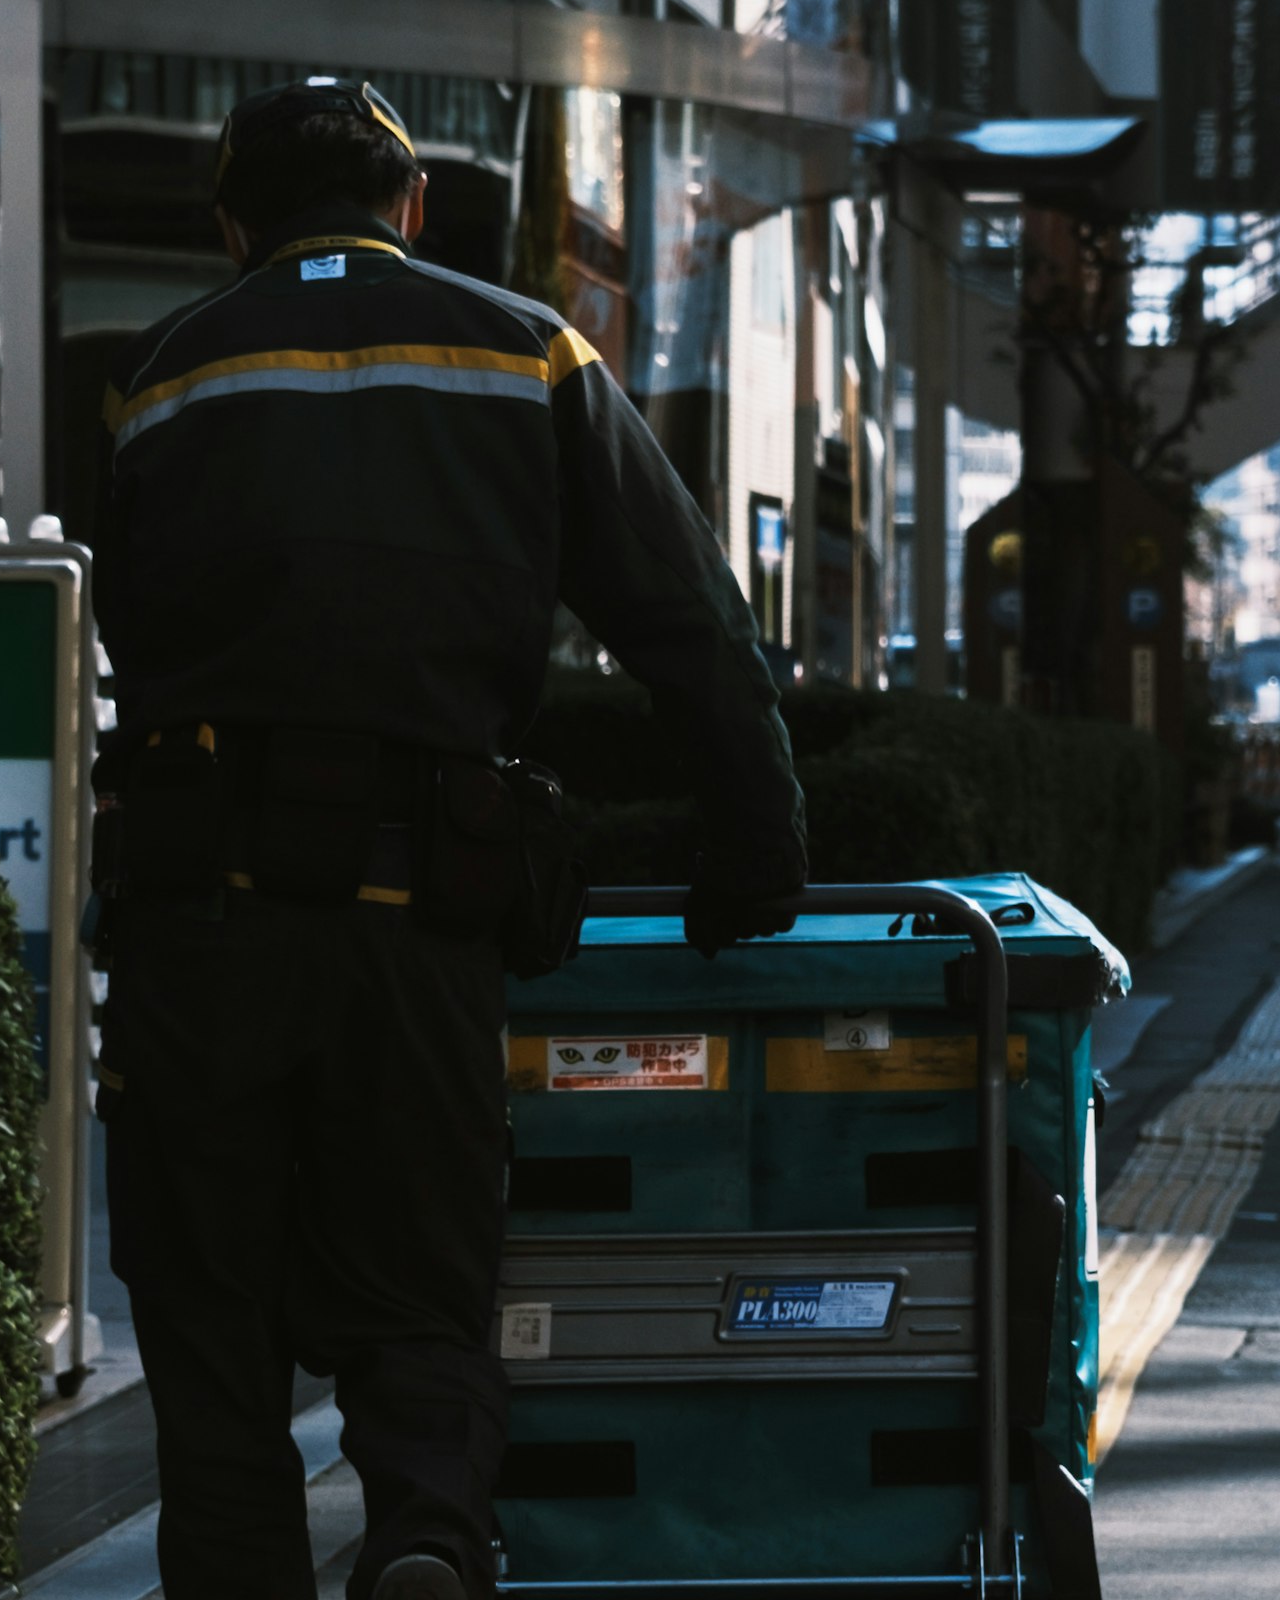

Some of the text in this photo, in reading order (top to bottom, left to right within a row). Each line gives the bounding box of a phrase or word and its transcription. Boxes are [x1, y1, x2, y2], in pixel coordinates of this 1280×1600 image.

[626, 1041, 701, 1058] 防犯カメラ
[736, 1299, 818, 1322] PLA300
